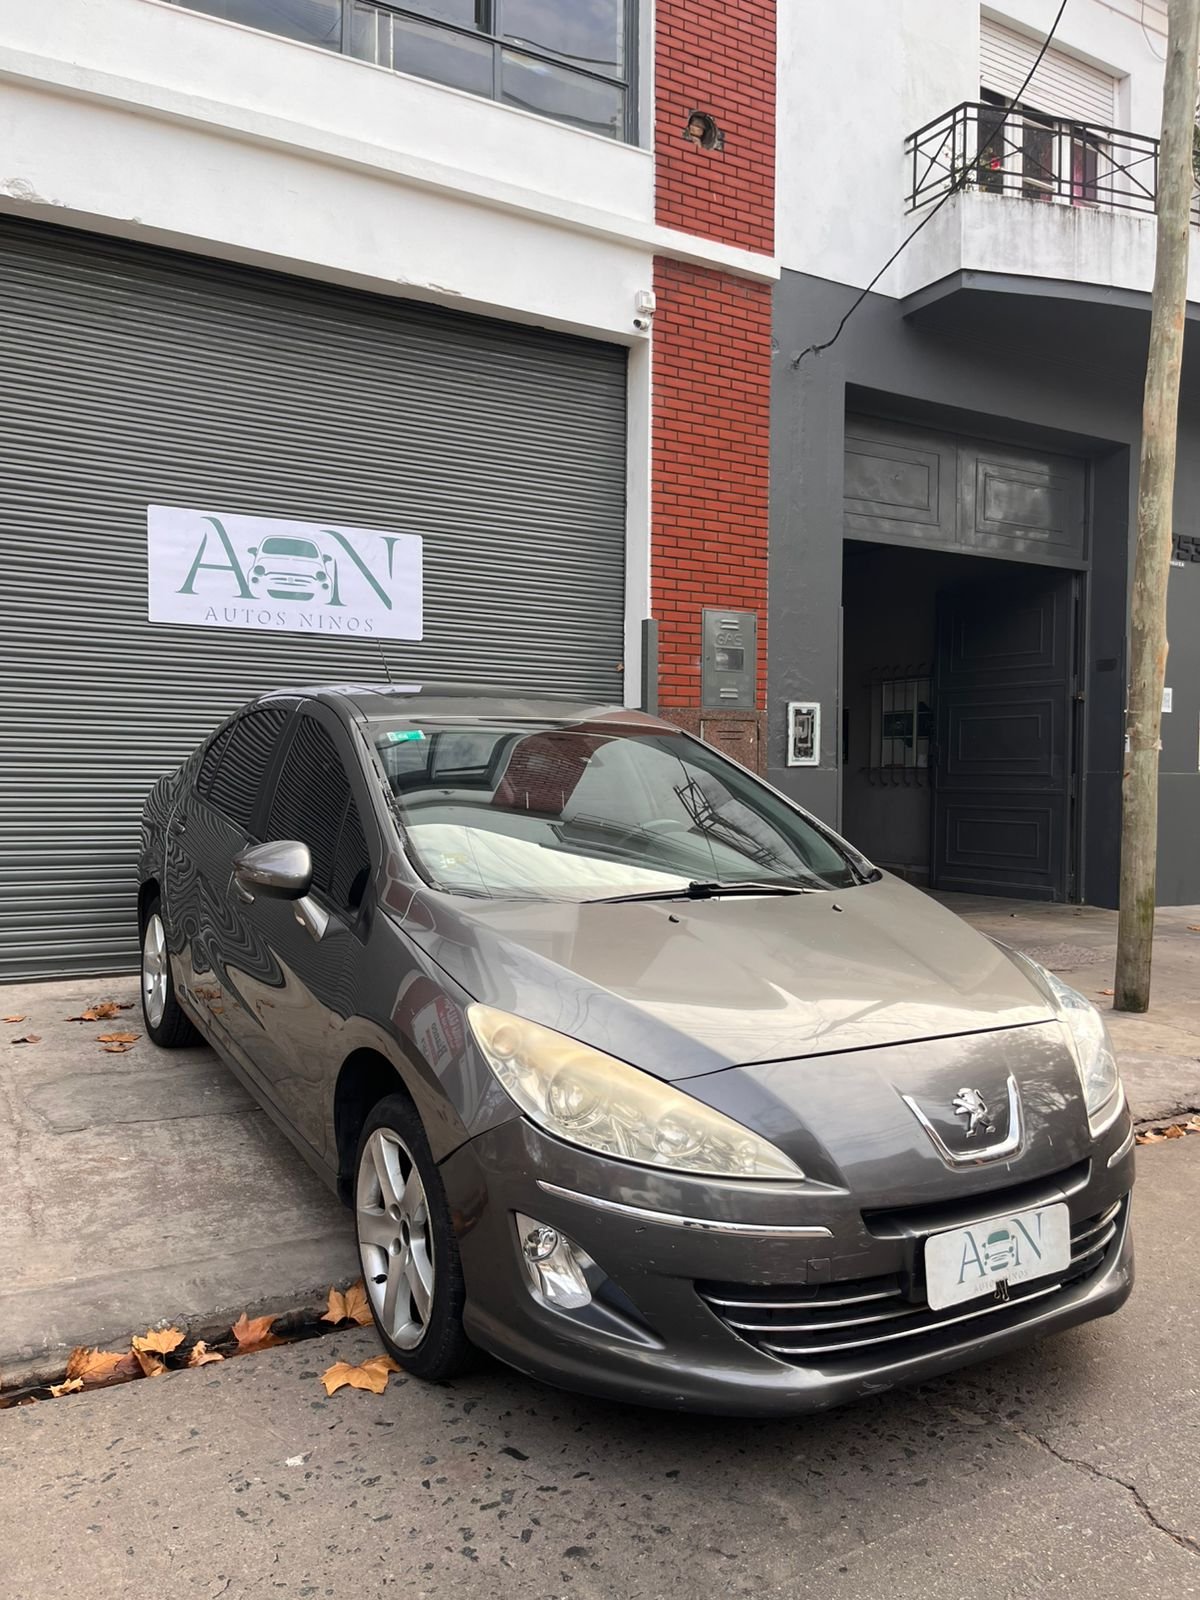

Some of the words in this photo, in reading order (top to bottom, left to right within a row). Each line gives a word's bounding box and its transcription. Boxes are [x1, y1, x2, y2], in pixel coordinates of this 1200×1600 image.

[204, 606, 286, 626] AUTOS
[299, 612, 374, 633] NINOS
[715, 632, 743, 646] GAS
